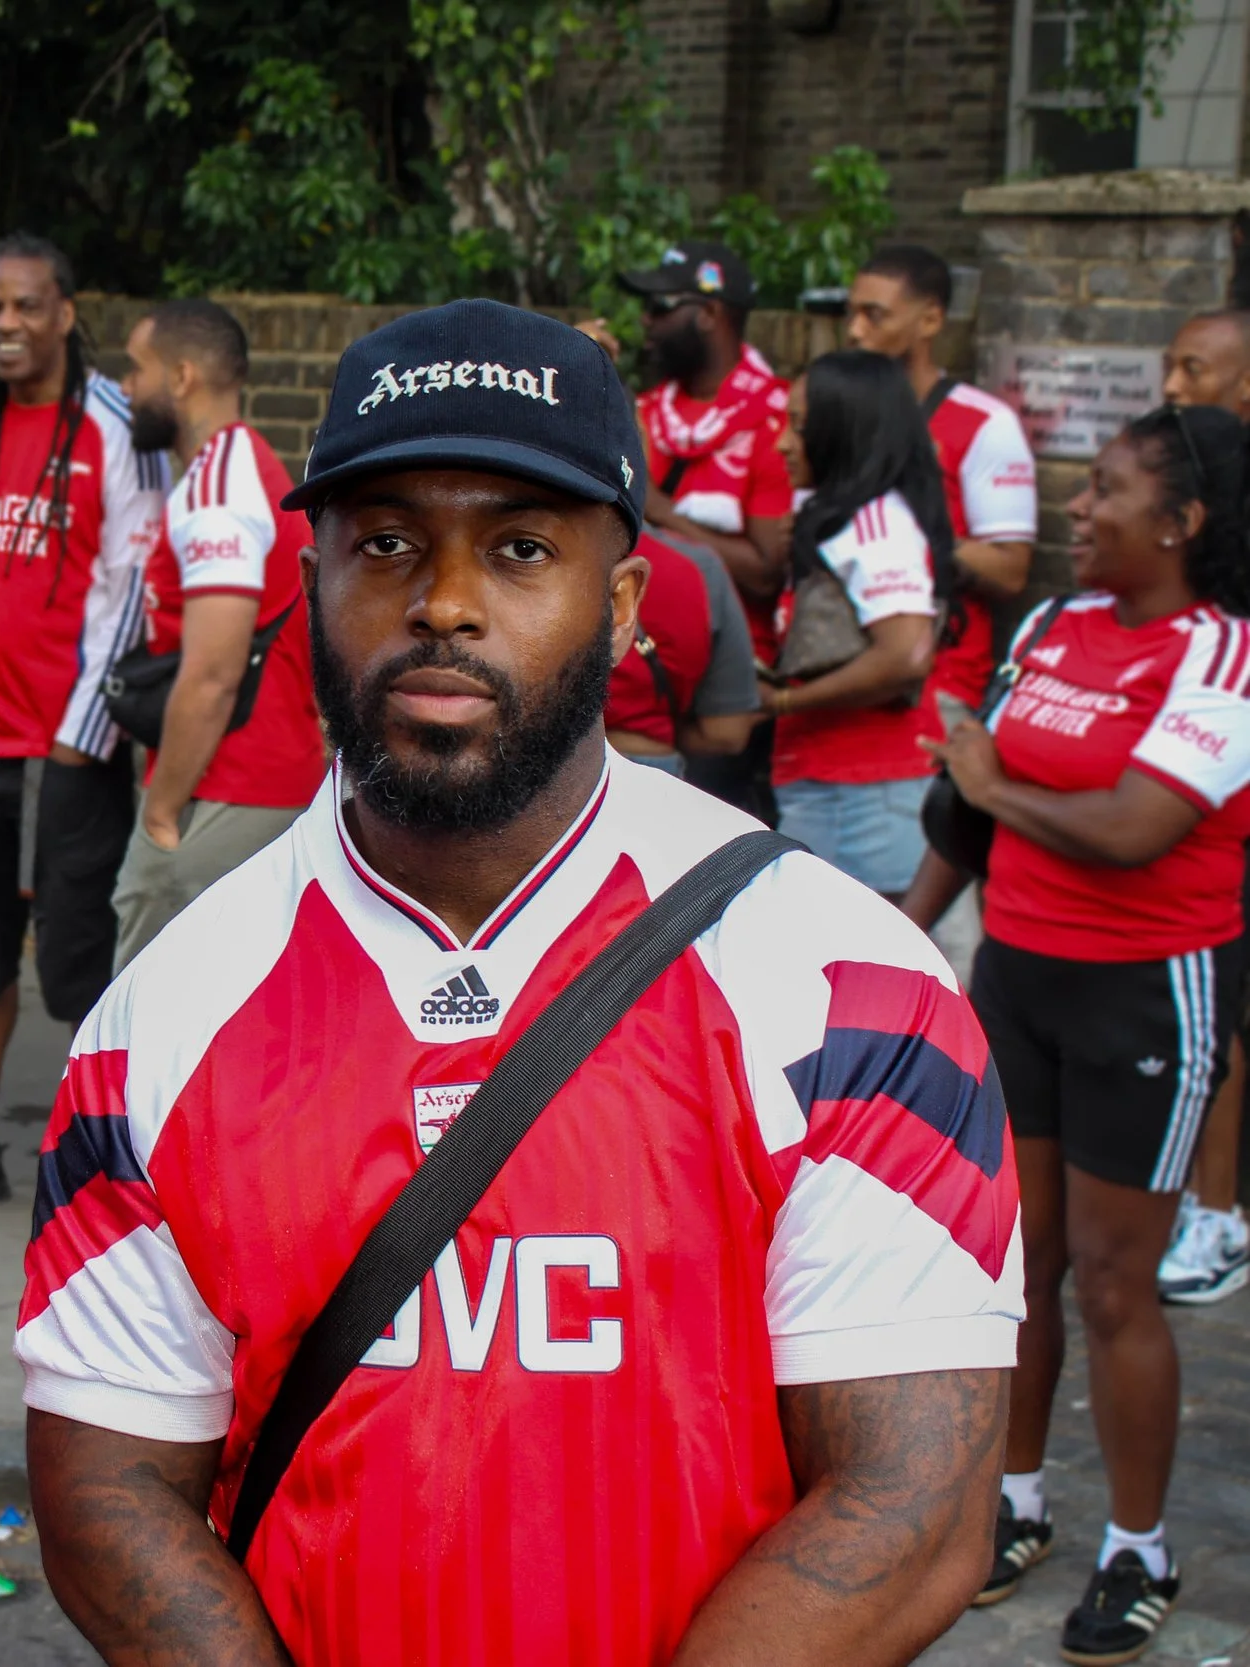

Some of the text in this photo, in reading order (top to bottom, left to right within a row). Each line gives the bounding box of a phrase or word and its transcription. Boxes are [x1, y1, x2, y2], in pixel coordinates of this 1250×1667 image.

[357, 360, 560, 415] Arsenal
[420, 995, 500, 1016] adidas
[420, 1012, 498, 1025] EQUIPMENT
[419, 1089, 475, 1108] Arsen
